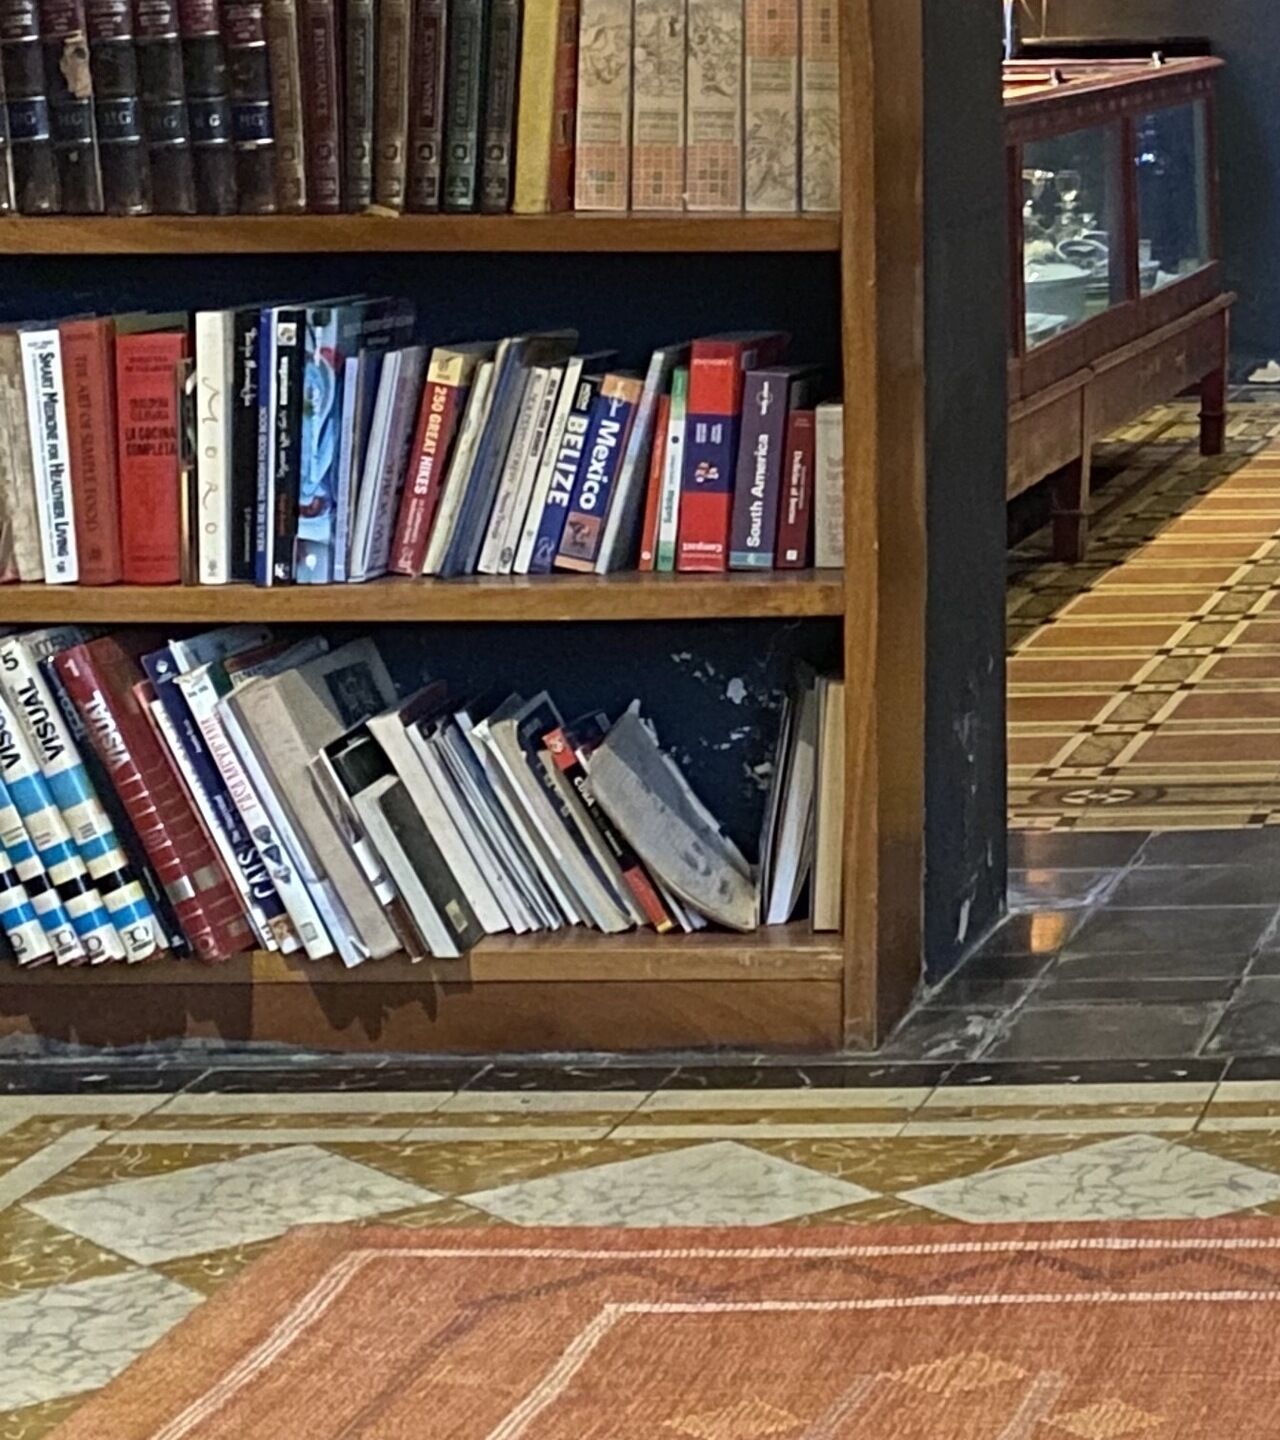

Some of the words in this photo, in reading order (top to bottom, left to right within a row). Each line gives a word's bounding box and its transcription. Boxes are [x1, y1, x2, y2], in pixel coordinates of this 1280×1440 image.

[38, 351, 55, 390] SMART
[545, 379, 556, 397] REAL
[43, 391, 60, 441] MEDICINE
[78, 384, 92, 410] ART
[430, 386, 448, 412] 250
[538, 399, 551, 429] BRITISH
[80, 413, 93, 429] OF
[125, 428, 138, 441] LA
[140, 427, 176, 441] COCINA
[260, 405, 268, 432] BOOK
[421, 413, 442, 454] GREAT
[48, 443, 59, 460] FOR
[82, 433, 96, 484] SIMPLE
[125, 442, 176, 457] COMPLETA
[202, 377, 220, 535] MORO
[259, 435, 267, 460] FOOD
[531, 430, 545, 458] DISHES
[547, 414, 588, 507] BELIZE
[258, 463, 266, 500] SWEDISH
[414, 456, 432, 495] HIKES
[579, 419, 620, 510] Mexico
[751, 433, 769, 494] America
[50, 462, 65, 519] HEALTHIER
[85, 489, 98, 532] FOOD
[258, 503, 266, 523] REAL
[746, 496, 763, 548] South
[55, 521, 69, 556] LIVING
[3, 650, 18, 671] 5
[18, 676, 66, 763] VISUAL
[83, 690, 130, 768] VISUAL
[200, 718, 246, 783] MEXICANA
[229, 783, 261, 816] CASA
[238, 842, 274, 899] CATS
